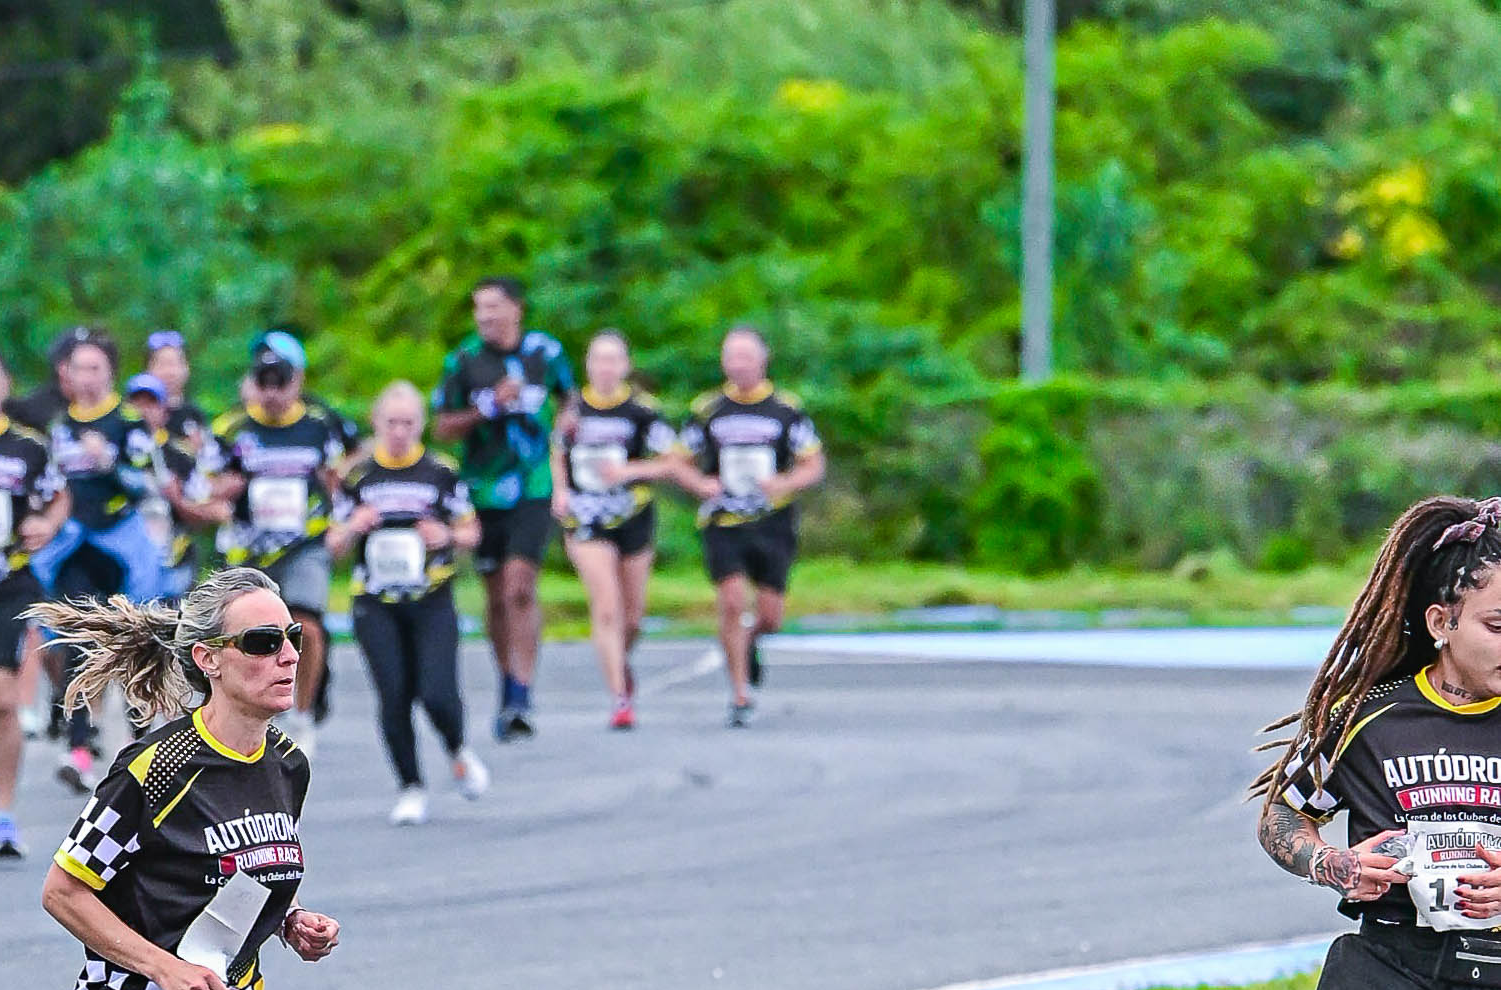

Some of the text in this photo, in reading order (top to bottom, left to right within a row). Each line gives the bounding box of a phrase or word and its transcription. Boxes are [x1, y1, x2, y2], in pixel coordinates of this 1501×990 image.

[1409, 786, 1476, 808] RUNNING
[1430, 812, 1442, 821] de
[1443, 812, 1456, 821] los
[1457, 811, 1488, 822] Clubes
[203, 808, 300, 855] AUTÓDROM
[234, 846, 301, 870] RUNNING RACE
[204, 875, 216, 884] La
